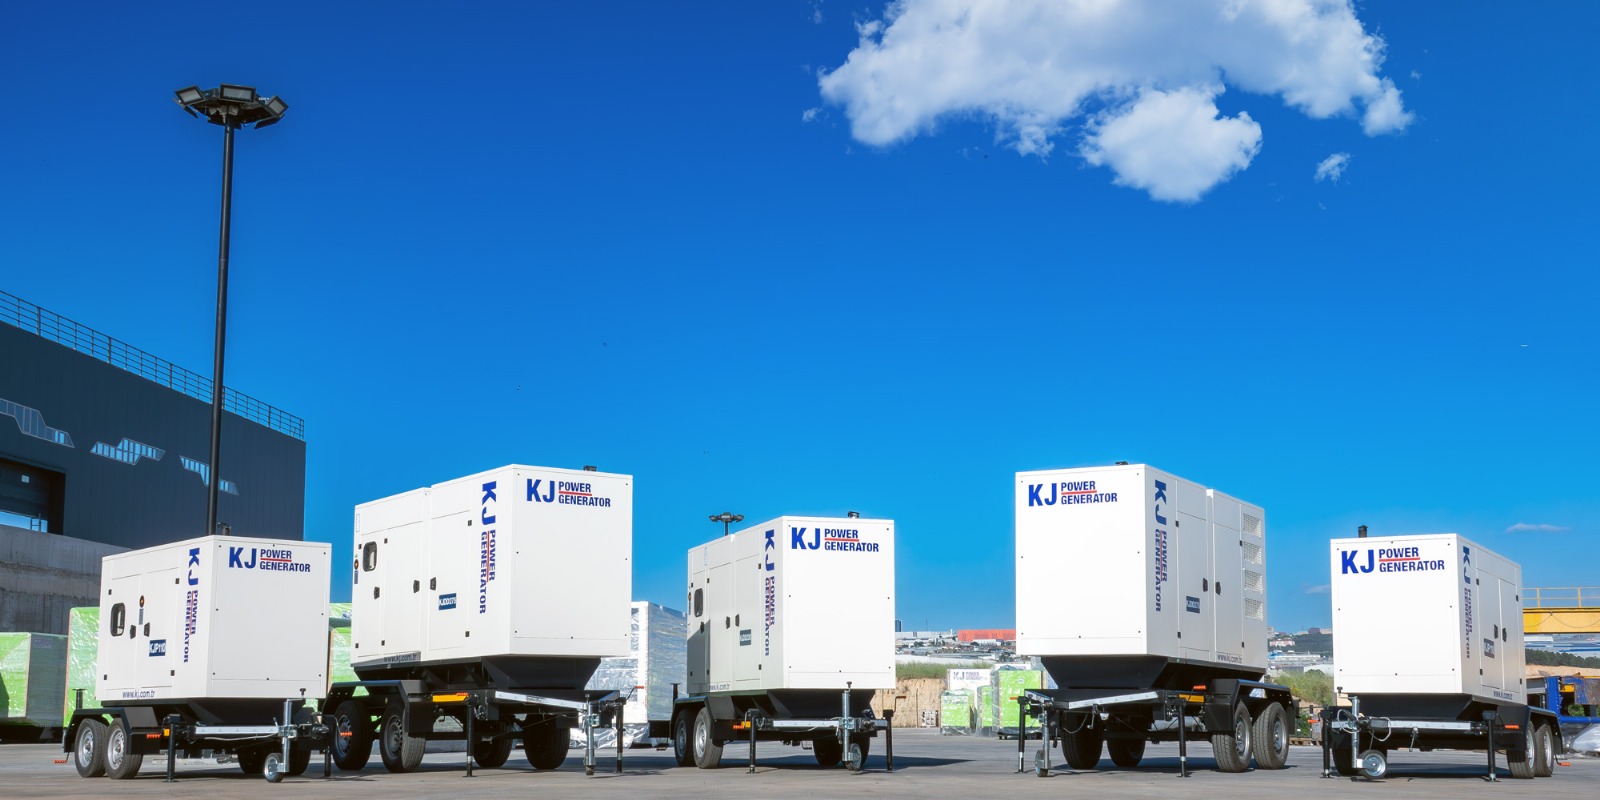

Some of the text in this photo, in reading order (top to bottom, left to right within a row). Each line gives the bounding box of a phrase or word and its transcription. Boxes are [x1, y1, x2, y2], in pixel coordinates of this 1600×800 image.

[526, 478, 556, 504] KJ
[558, 480, 592, 493] POWER
[1028, 482, 1058, 507] KJ
[1060, 480, 1096, 492] POWER
[481, 480, 497, 526] KJ
[558, 494, 611, 508] GENERATOR
[1060, 492, 1118, 506] GENERATOR
[1154, 479, 1168, 526] KJ
[791, 527, 821, 551] KJ
[824, 528, 859, 539] POWER
[228, 546, 258, 570] KJ
[260, 548, 293, 560] POWER
[488, 529, 496, 581] POWER
[764, 529, 775, 572] KJ
[824, 541, 880, 553] GENERATOR
[1378, 546, 1420, 559] POWER
[187, 547, 201, 587] KJ
[259, 560, 311, 573] GENERATOR
[479, 531, 488, 615] GENERATOR
[1341, 549, 1375, 575] KJ
[1378, 559, 1445, 573] GENERATOR
[1462, 545, 1471, 585] KJ
[191, 590, 199, 635] POWER
[183, 591, 192, 663] GENERATOR
[122, 689, 155, 699] www.kj.com.tr
